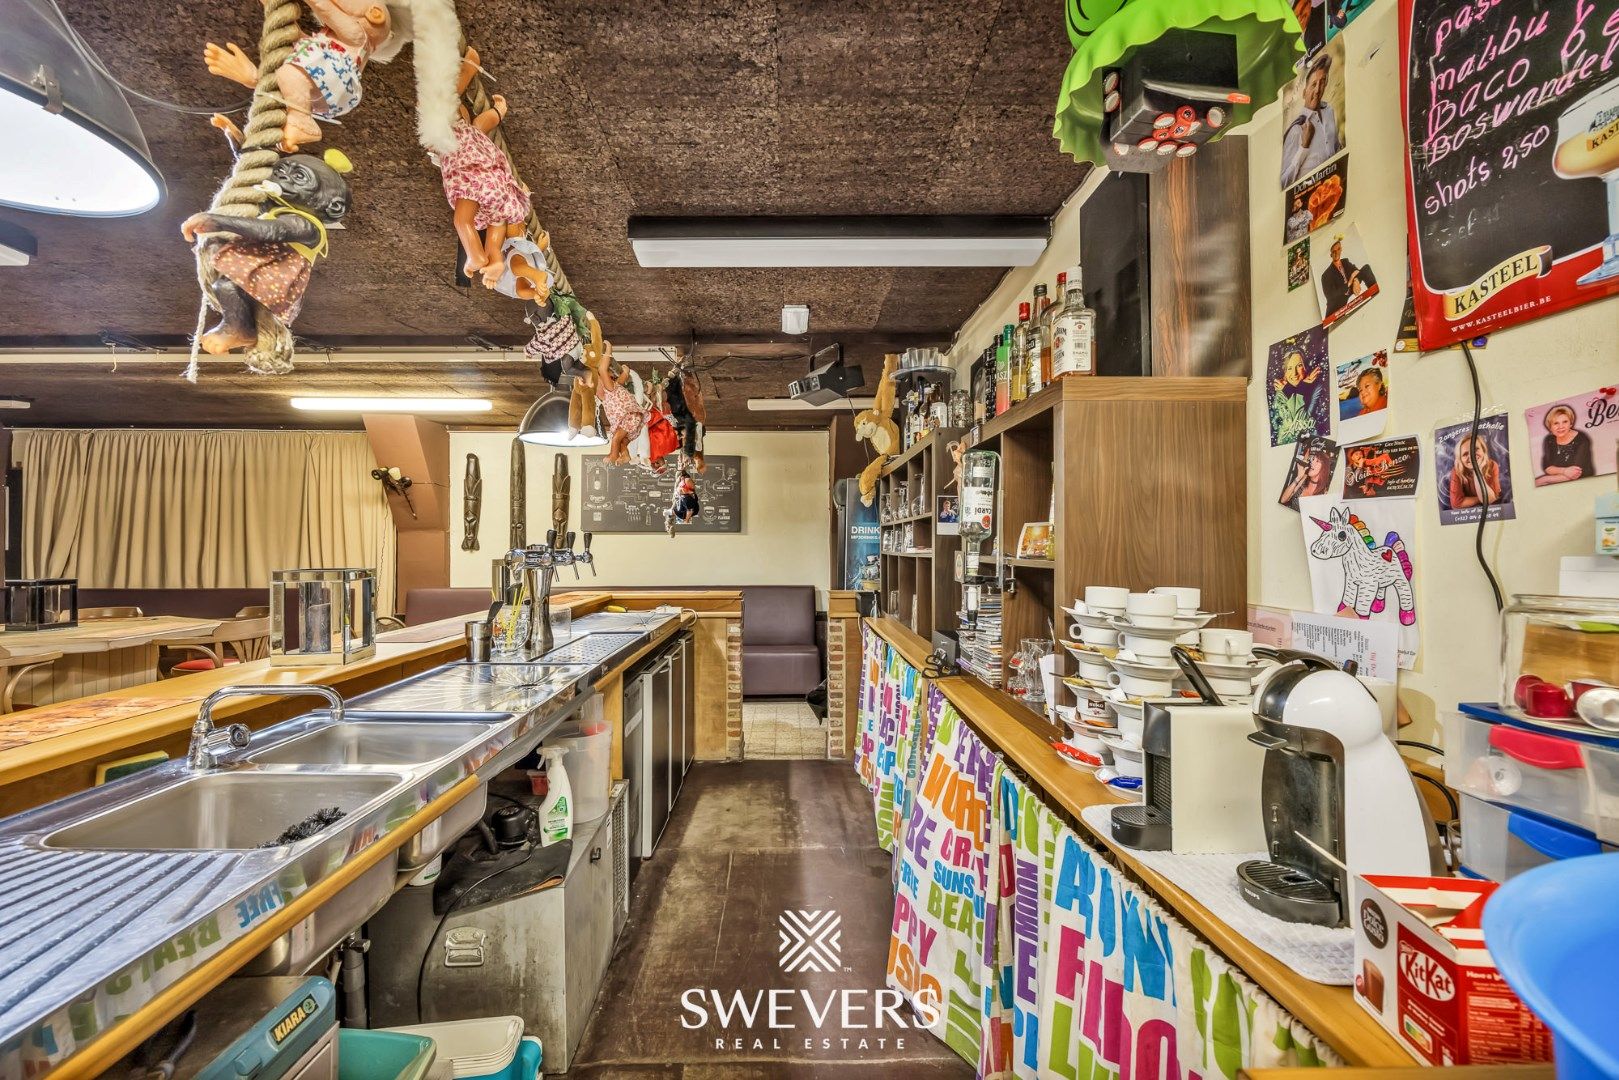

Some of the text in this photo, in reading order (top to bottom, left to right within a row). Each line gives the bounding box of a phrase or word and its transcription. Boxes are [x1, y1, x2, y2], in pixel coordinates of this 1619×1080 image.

[1424, 125, 1550, 215] shots 2,50
[1453, 254, 1538, 315] KASTEEL
[1450, 295, 1551, 333] WWW.KASTEELBIER.BE
[1405, 952, 1451, 999] KitKat
[274, 1006, 306, 1042] KIARA
